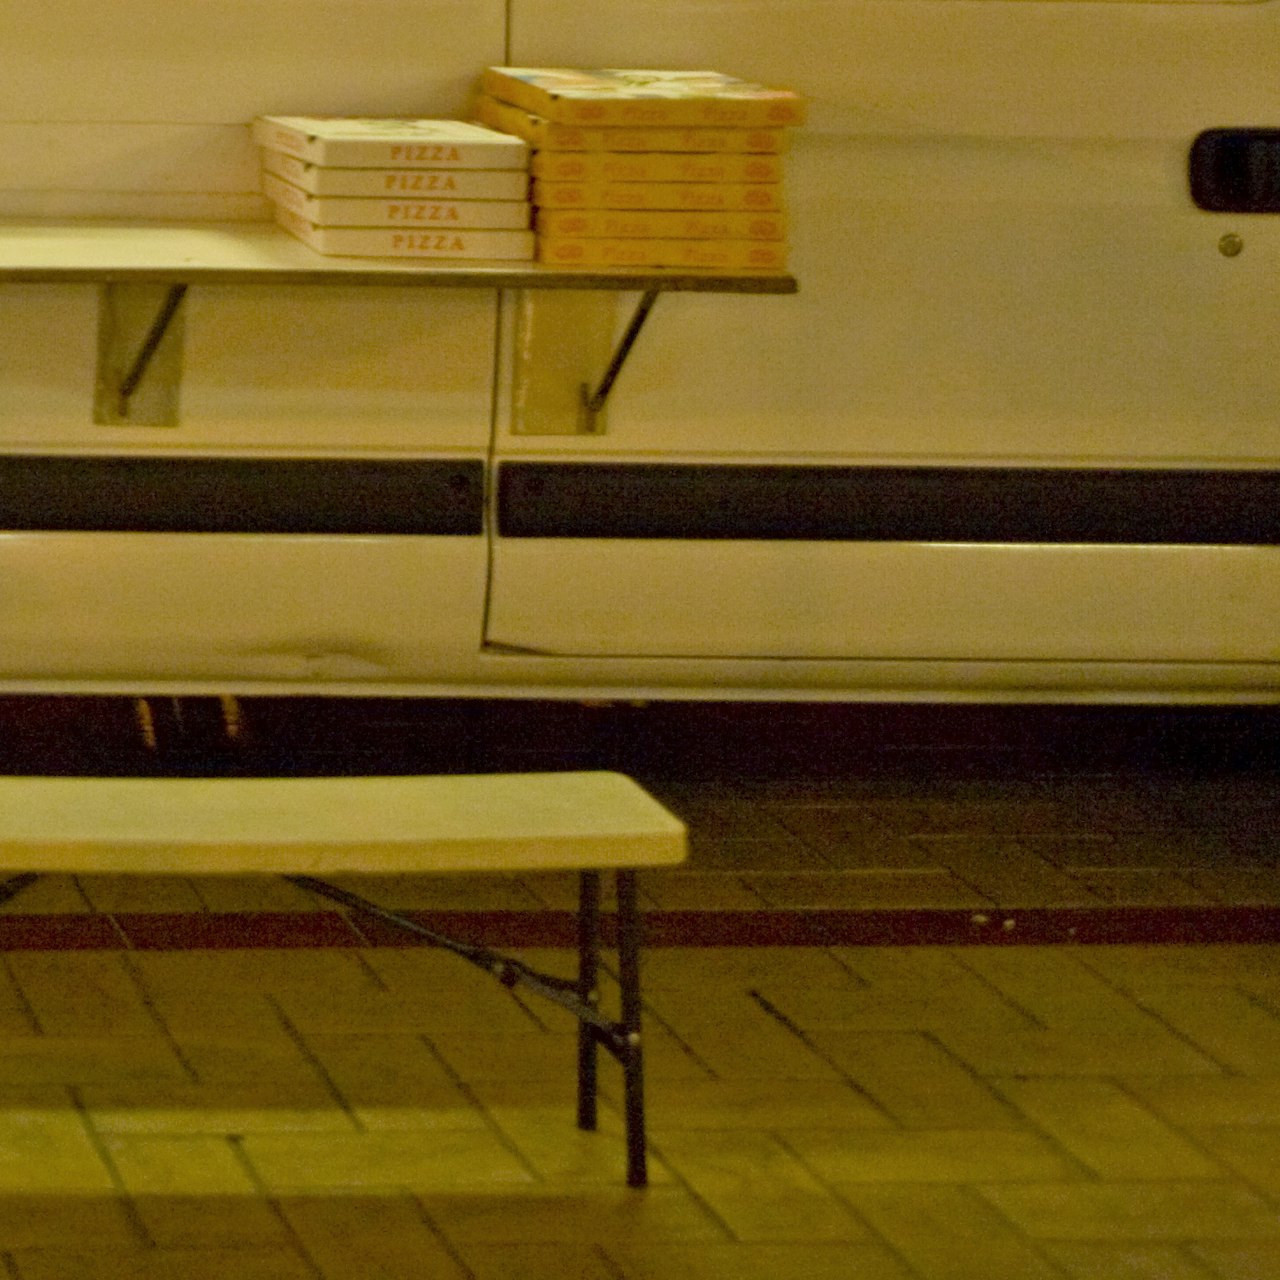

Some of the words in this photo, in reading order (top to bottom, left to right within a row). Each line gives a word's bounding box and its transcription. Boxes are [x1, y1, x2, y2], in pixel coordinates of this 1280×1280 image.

[391, 146, 460, 161] PIZZA
[385, 175, 457, 190] PIZZA
[389, 205, 459, 221] PIZZA
[392, 235, 465, 251] PIZZA
